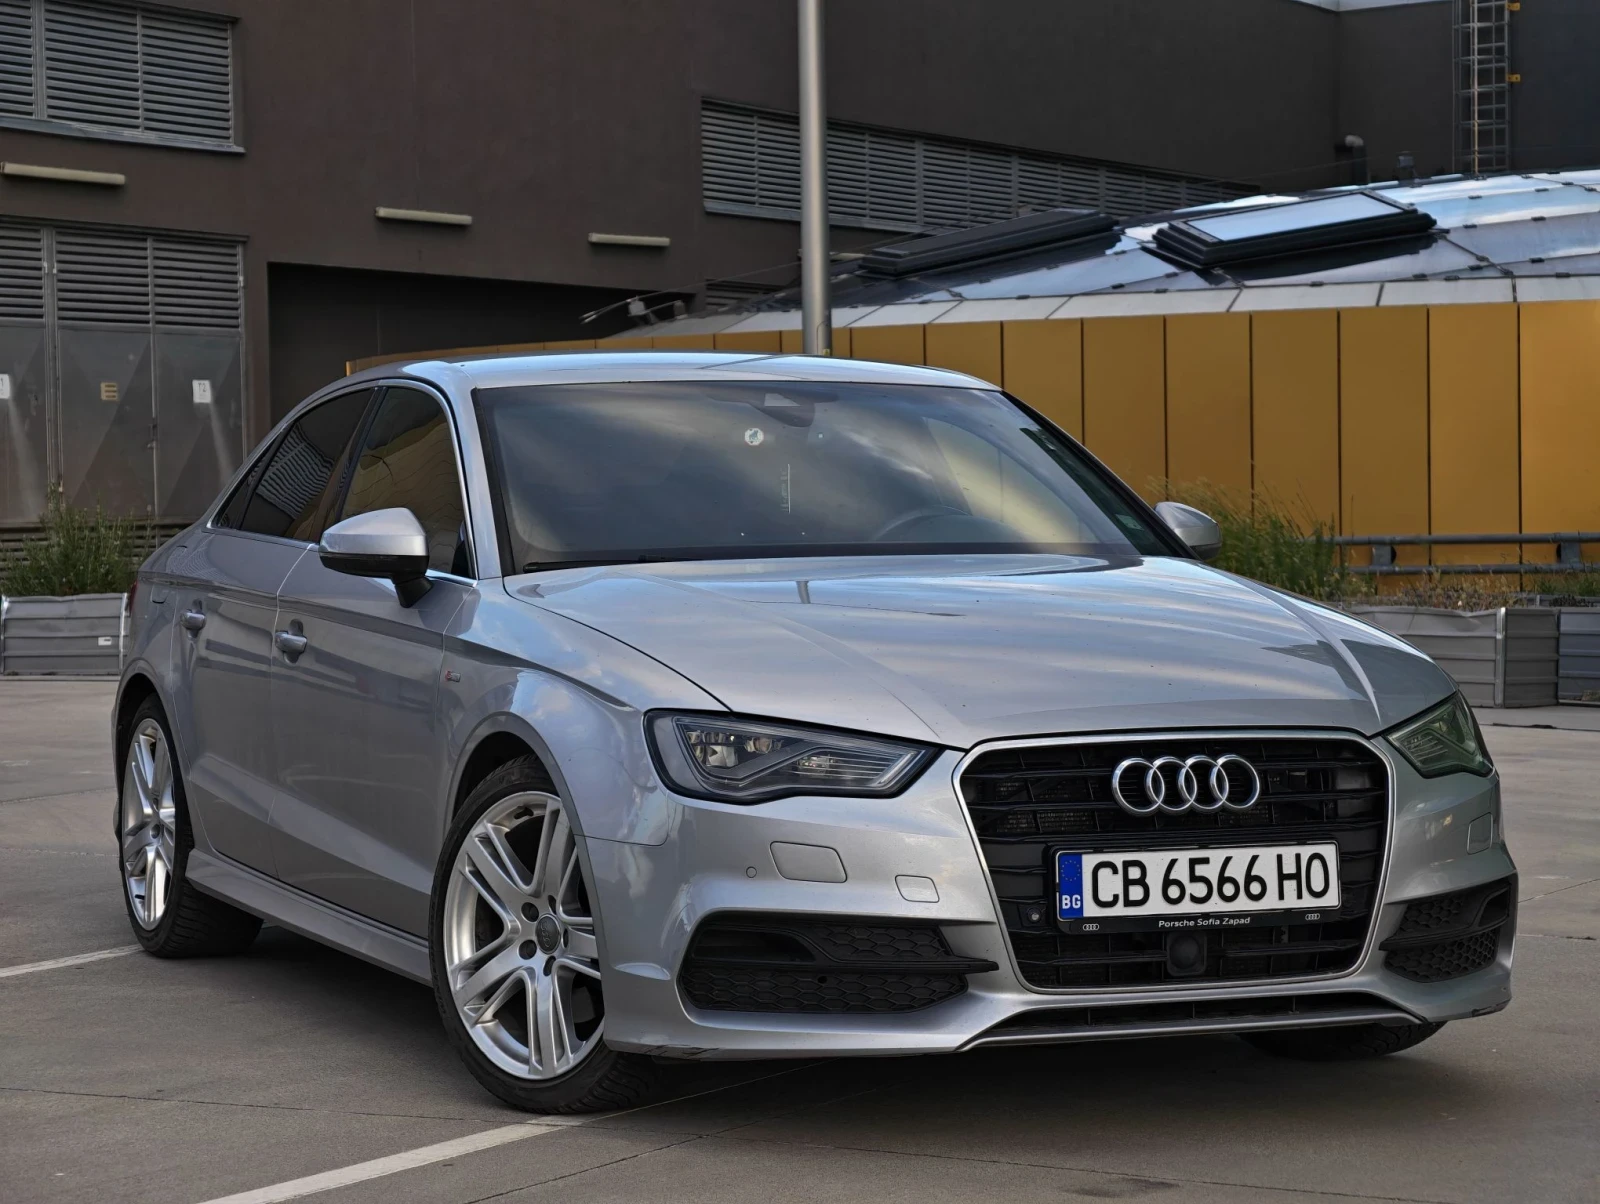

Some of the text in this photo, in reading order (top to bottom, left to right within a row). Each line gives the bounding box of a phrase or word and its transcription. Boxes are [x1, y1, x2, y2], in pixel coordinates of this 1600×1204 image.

[1092, 852, 1330, 908] CB 6566 HO
[1062, 895, 1081, 909] BG
[1158, 917, 1251, 928] Porsche Sofia Zapad
